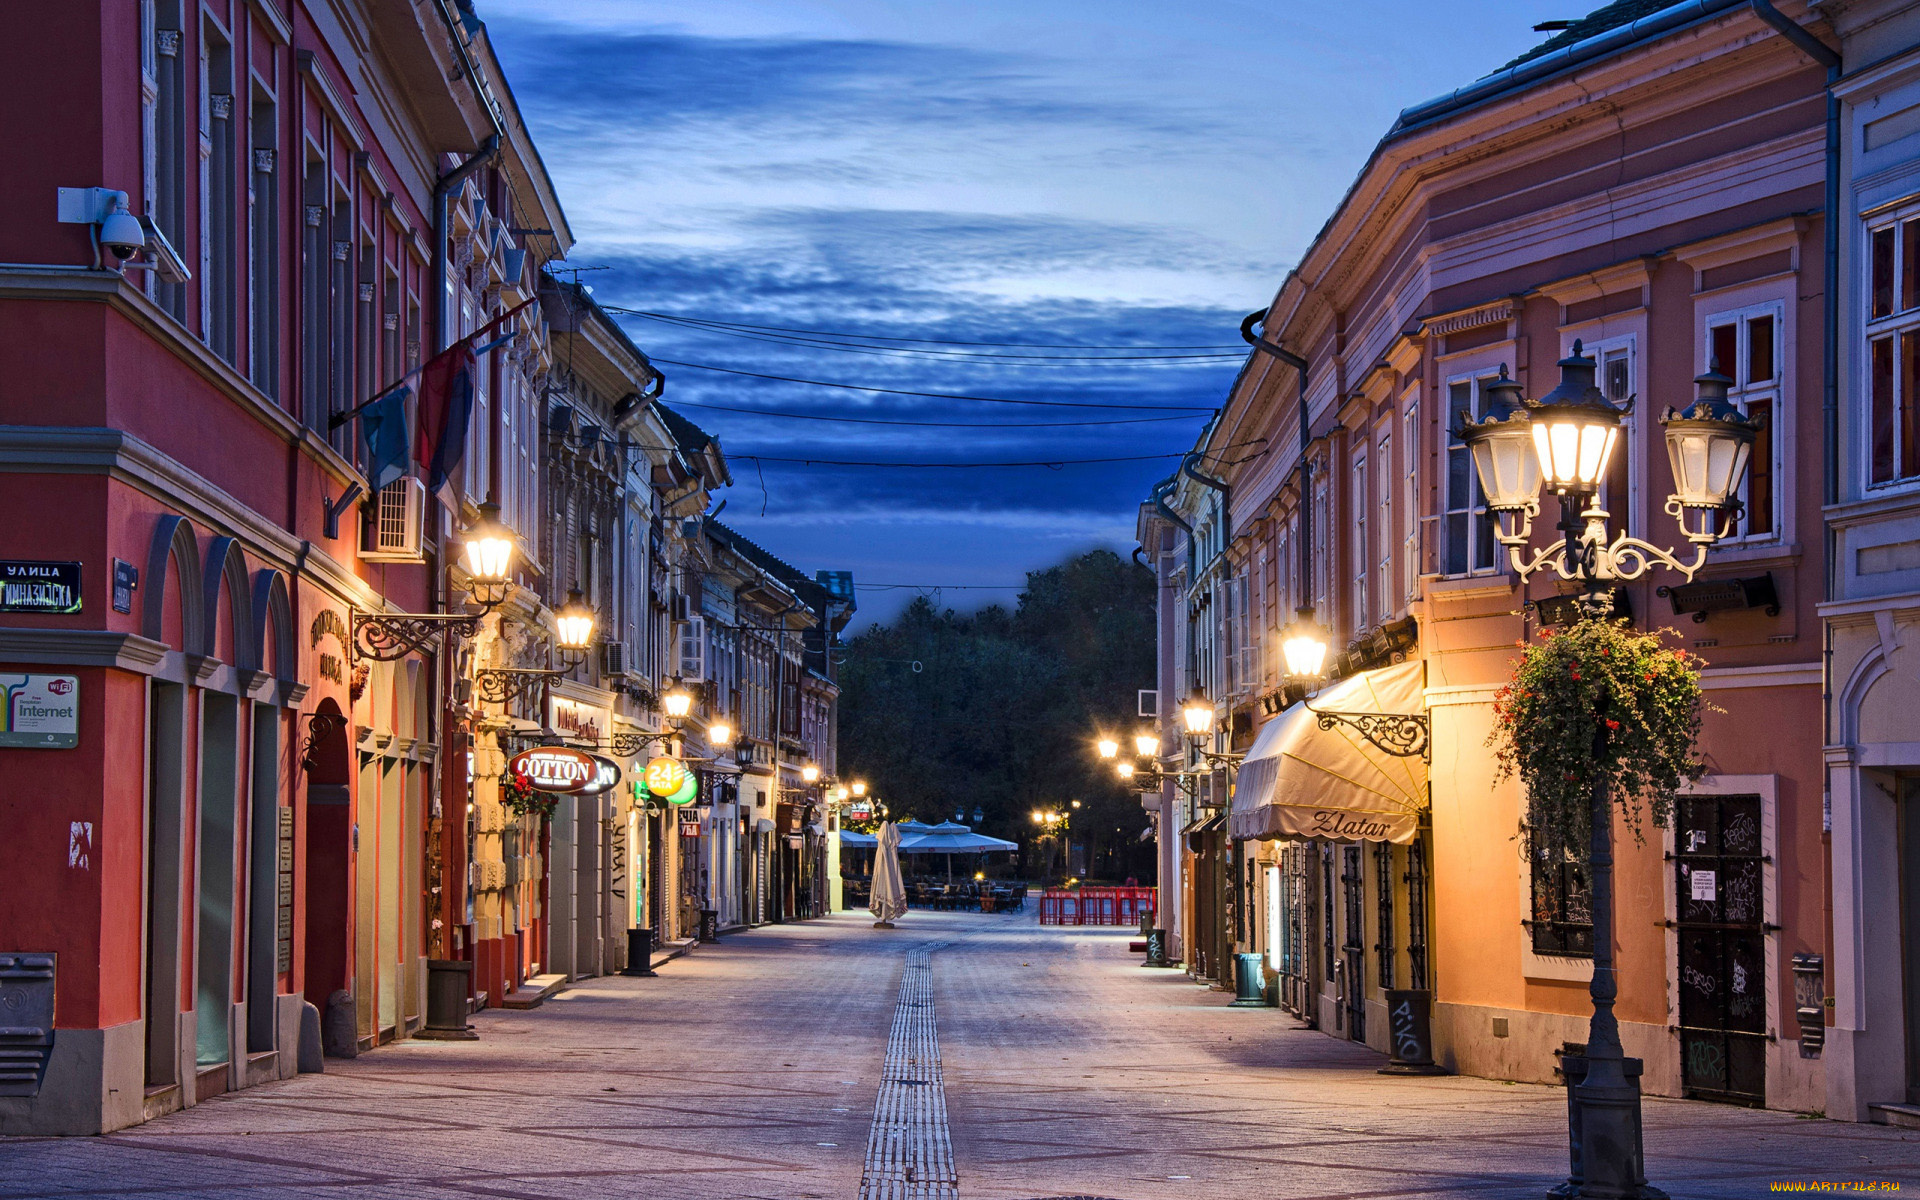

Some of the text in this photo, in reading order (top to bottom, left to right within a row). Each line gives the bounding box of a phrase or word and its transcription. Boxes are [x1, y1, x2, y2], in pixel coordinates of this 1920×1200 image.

[7, 566, 60, 577] УЛИЦА
[19, 704, 73, 718] Internet
[517, 758, 590, 781] COTTON
[649, 763, 672, 781] 24
[649, 781, 672, 790] SATA
[1311, 810, 1391, 837] Zlatar
